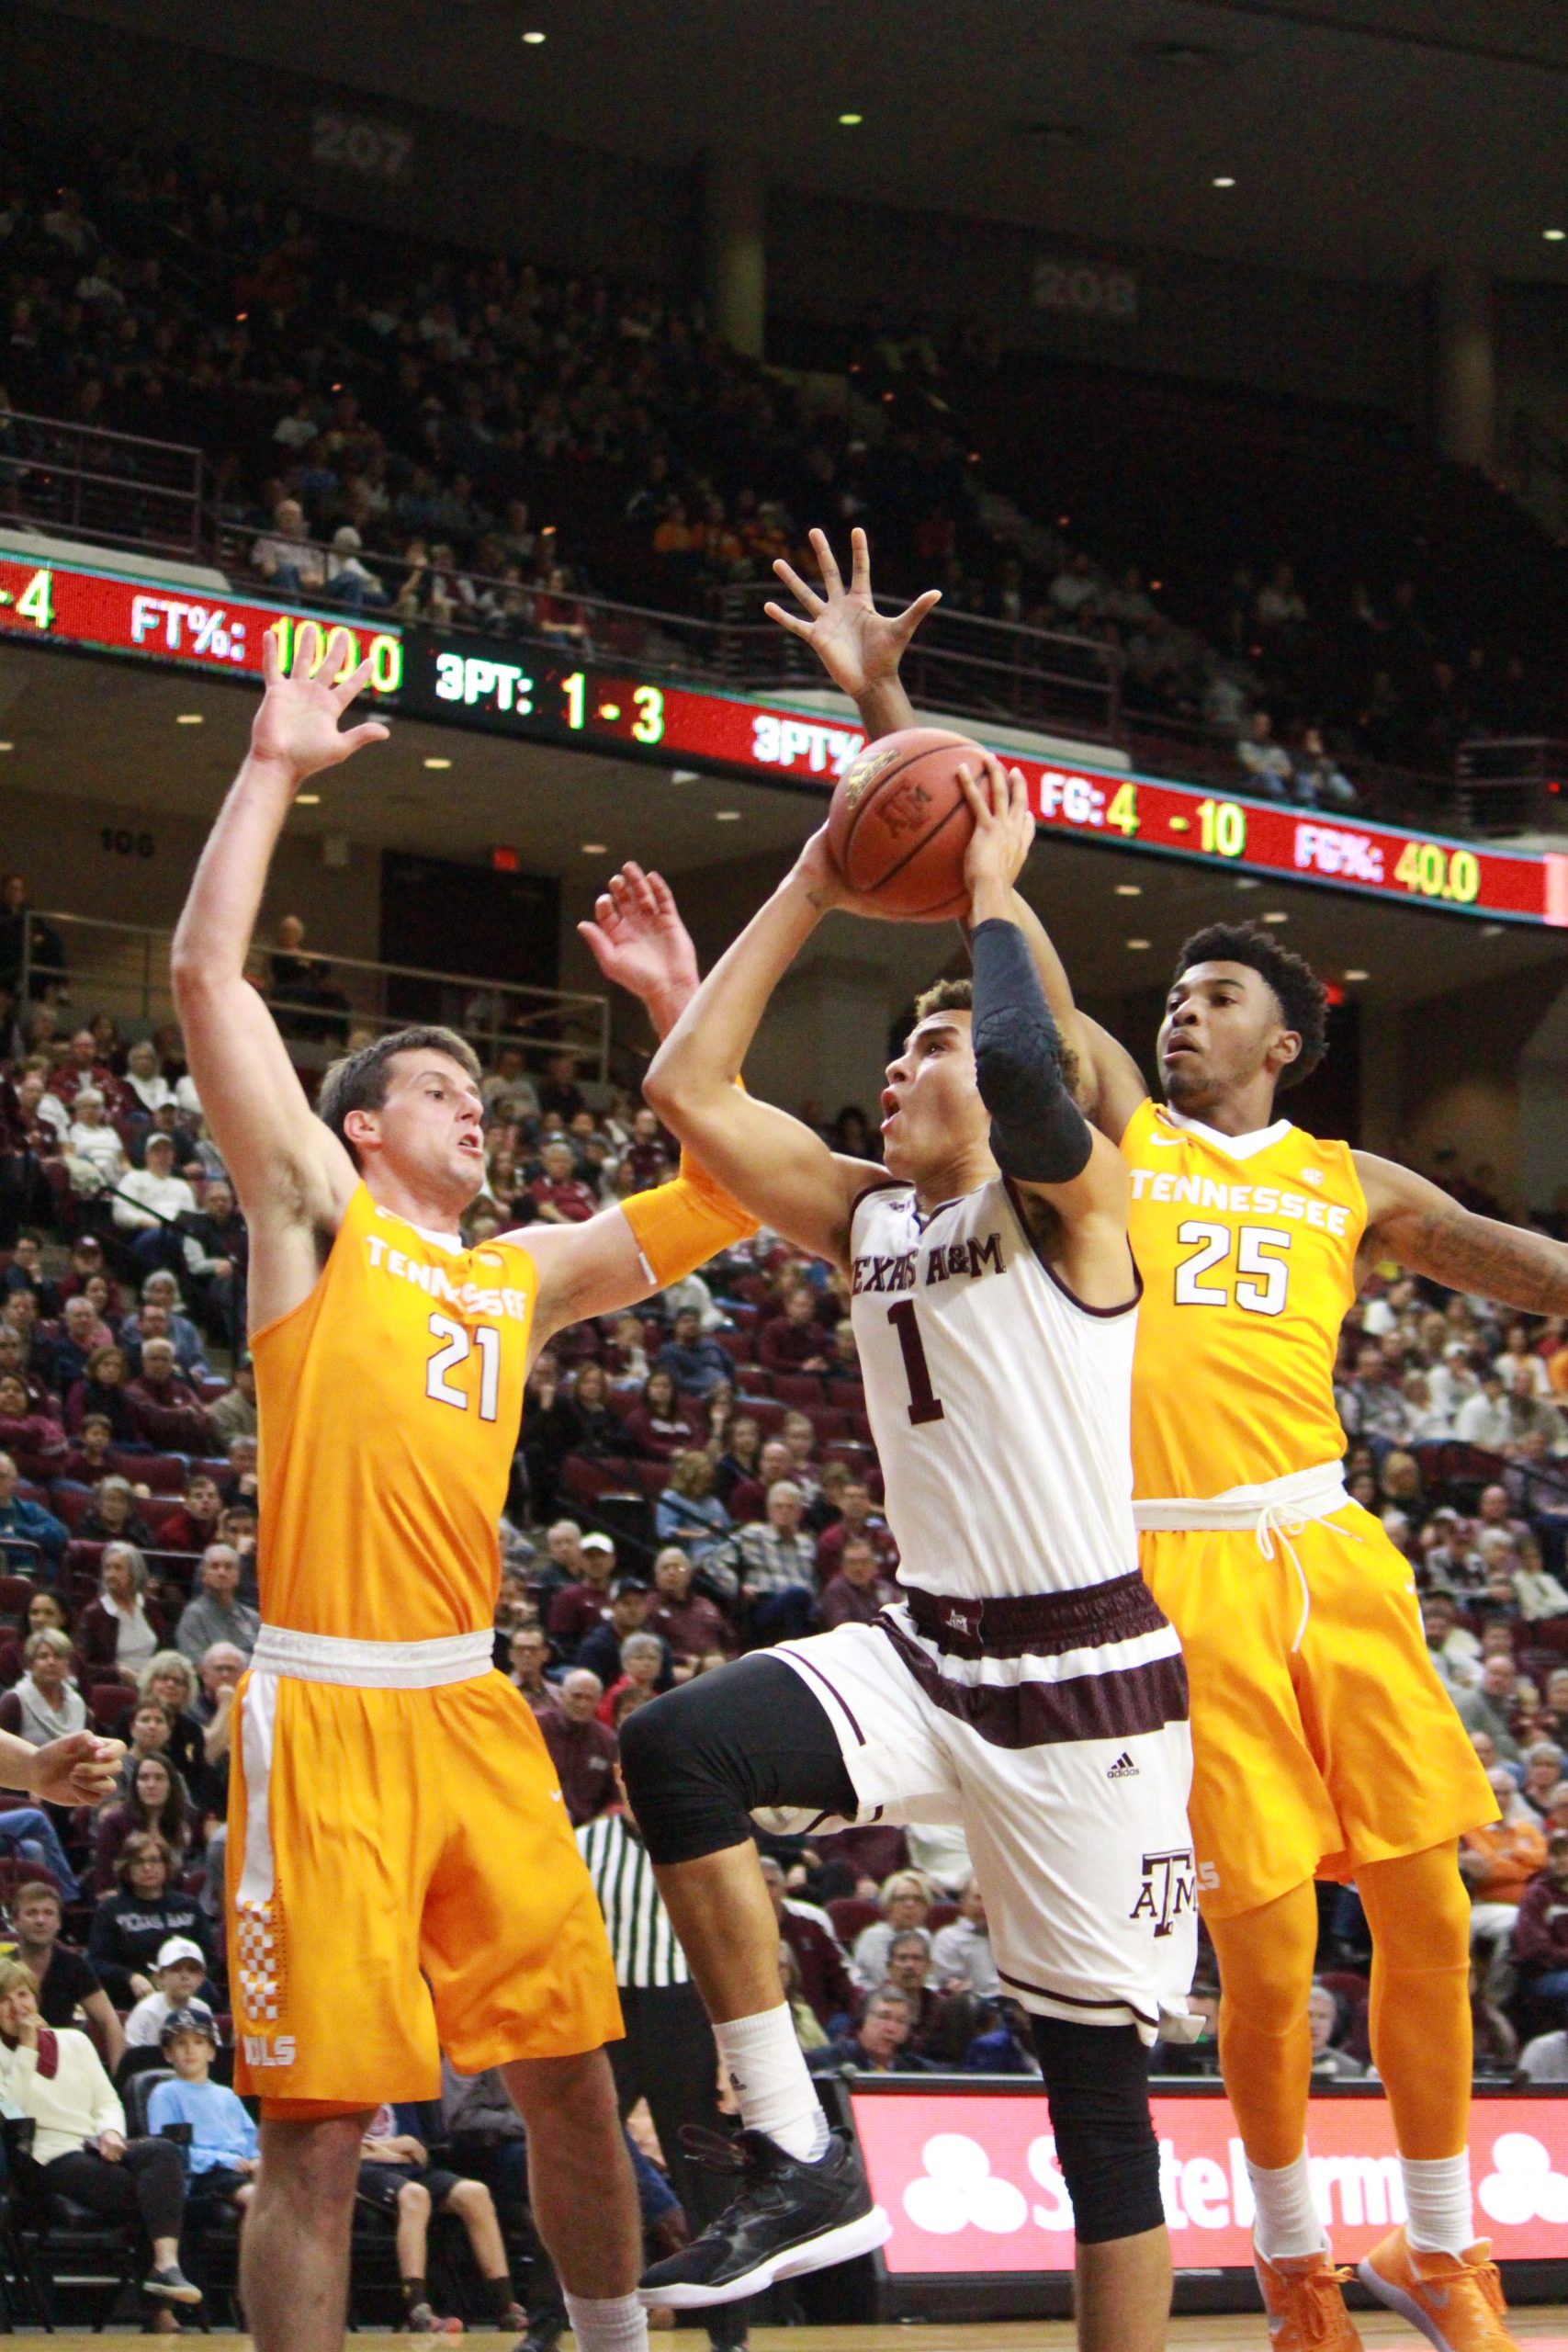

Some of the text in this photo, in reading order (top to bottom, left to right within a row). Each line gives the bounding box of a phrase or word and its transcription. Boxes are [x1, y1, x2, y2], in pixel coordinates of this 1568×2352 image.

[311, 115, 414, 175] 207
[17, 570, 53, 629] 4
[130, 594, 245, 662] FT%:
[435, 652, 534, 716] 3PT:
[561, 672, 585, 730] 1
[632, 685, 664, 744] 3
[1040, 772, 1105, 826] FG:
[1106, 782, 1140, 837] 4
[1197, 798, 1247, 857] 10
[1294, 823, 1481, 903] FG%: 40.0
[1130, 1170, 1351, 1238] TENNESSEE
[852, 1232, 1007, 1295] EXAS A&M
[1174, 1220, 1292, 1317] 25
[426, 1312, 501, 1423] 21
[887, 1299, 944, 1425] 1
[1107, 1768, 1140, 1779] adidas
